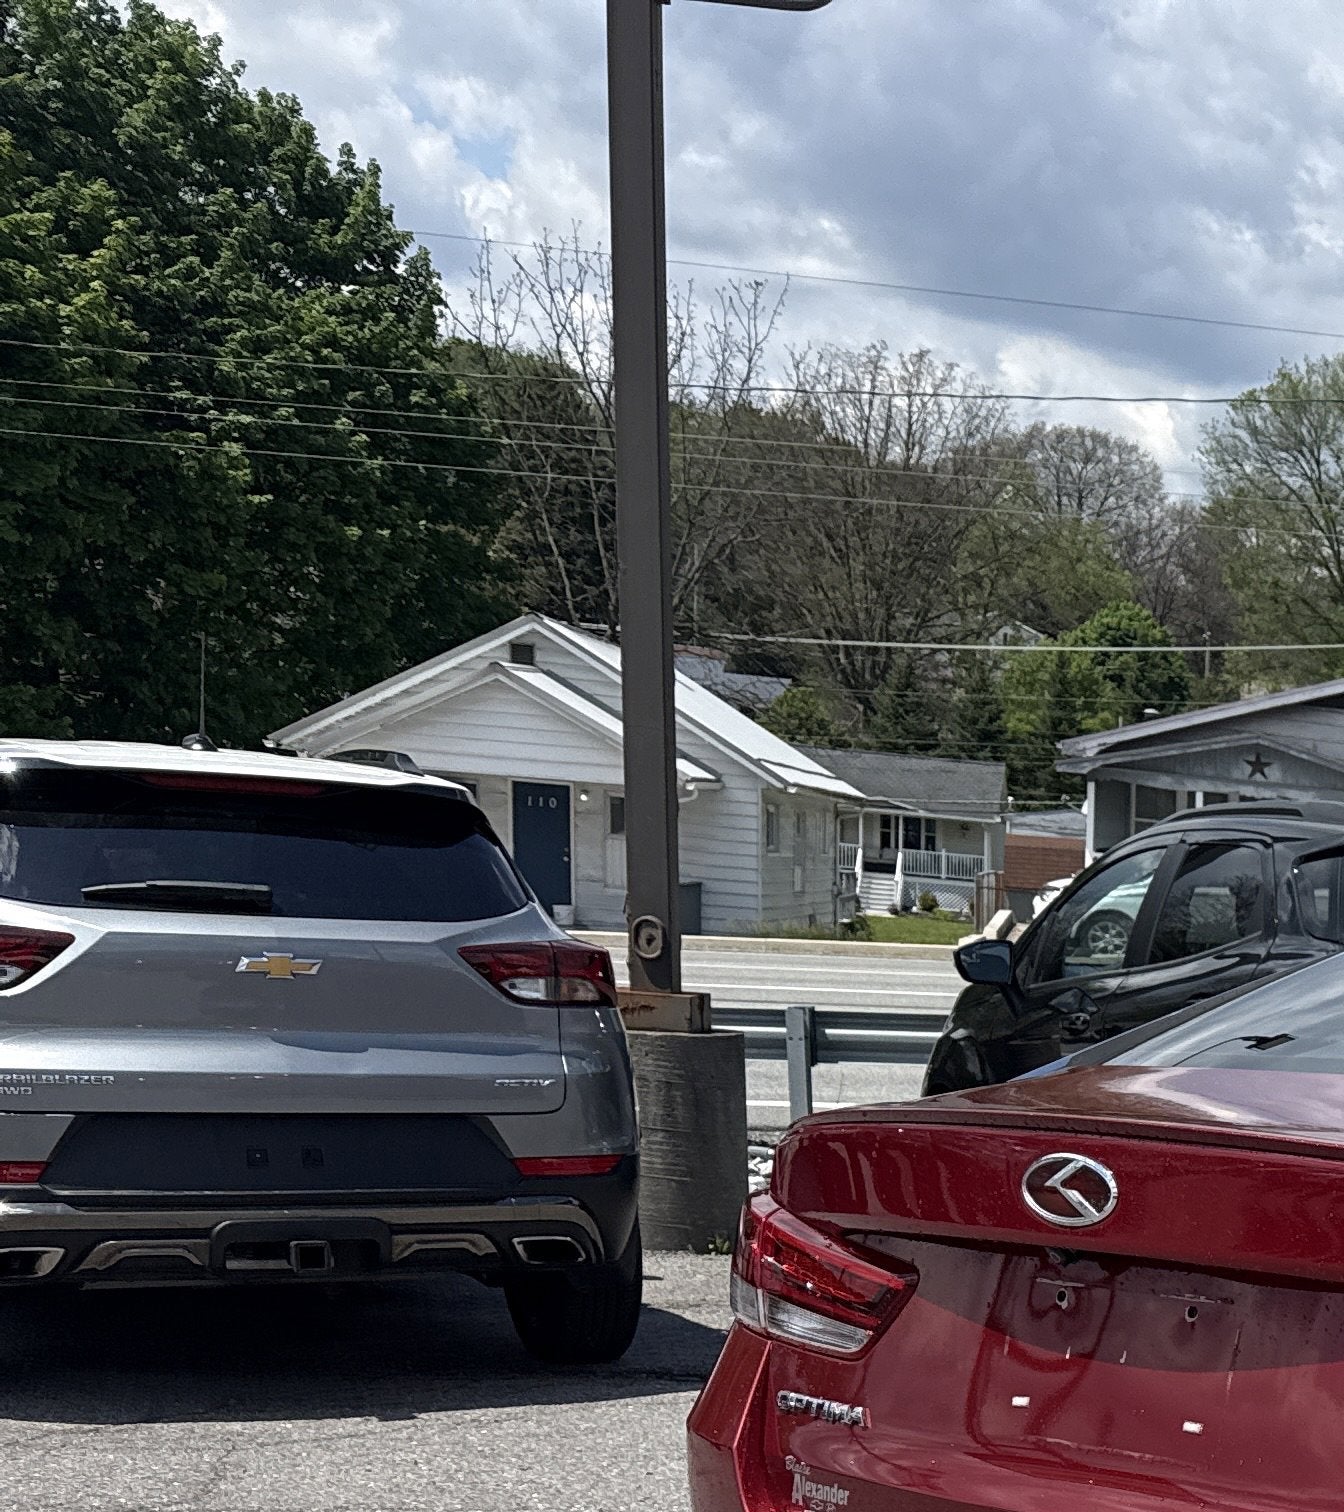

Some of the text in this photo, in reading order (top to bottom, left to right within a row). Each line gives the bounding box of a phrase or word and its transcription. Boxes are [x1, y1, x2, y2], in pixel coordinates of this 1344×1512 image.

[527, 795, 558, 809] 110
[0, 1073, 115, 1085] RAILBLAZER
[777, 1390, 868, 1428] OPTIMA
[792, 1473, 850, 1506] Alexander
